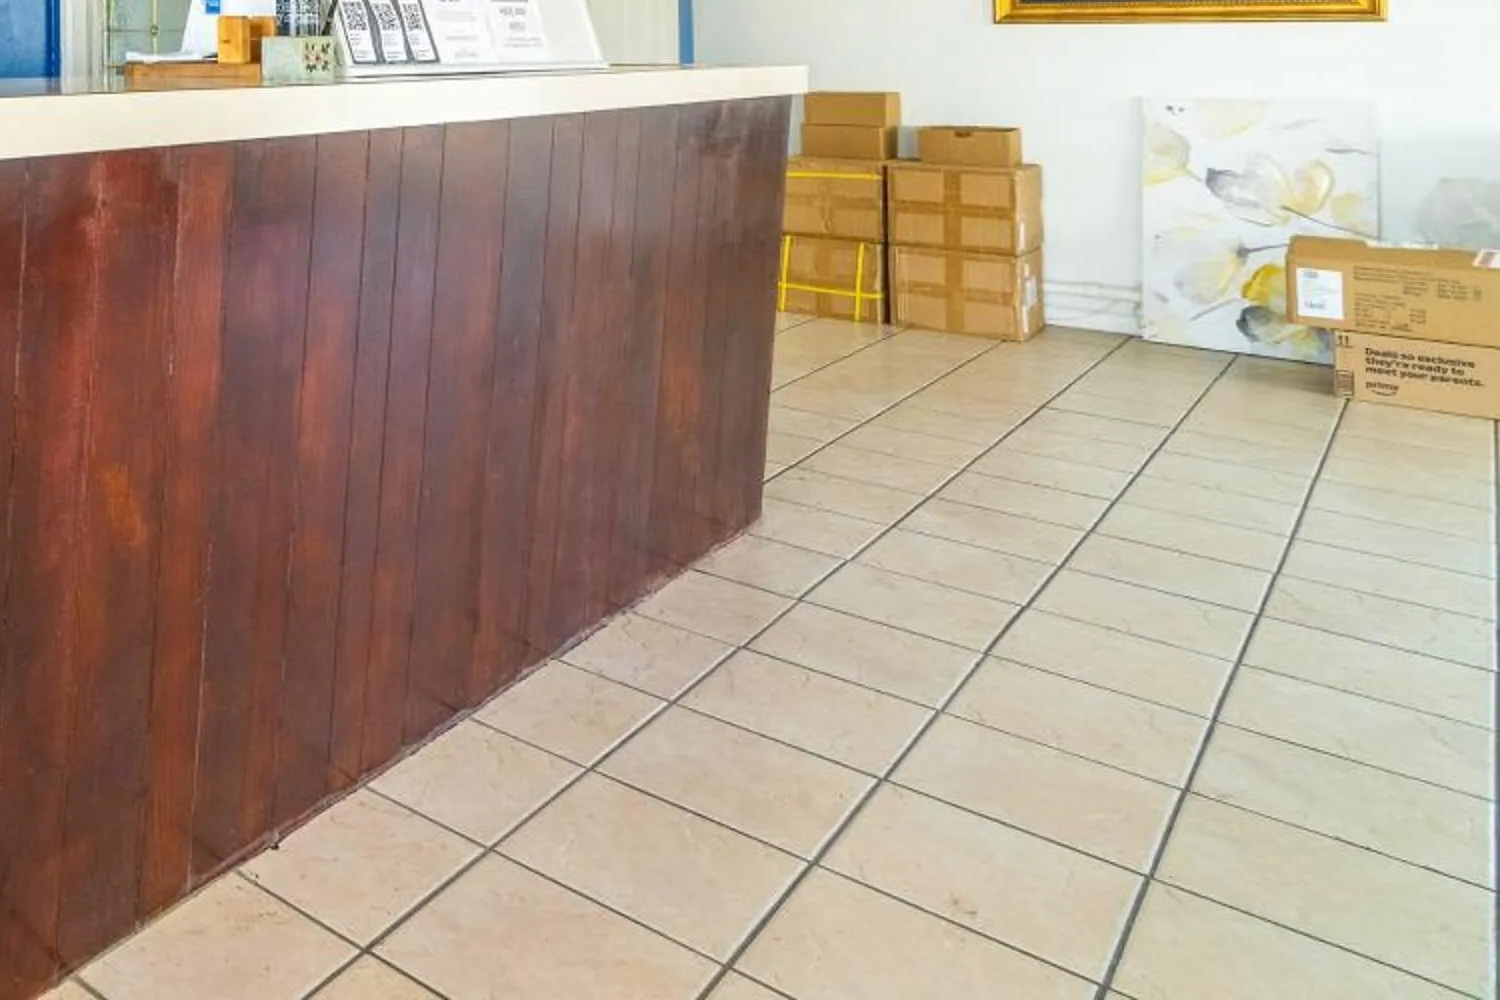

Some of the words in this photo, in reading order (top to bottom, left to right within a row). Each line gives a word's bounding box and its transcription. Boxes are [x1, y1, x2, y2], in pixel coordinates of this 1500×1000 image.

[1364, 347, 1398, 358] Deals
[1400, 352, 1415, 361] so
[1417, 354, 1476, 368] exclusive
[1364, 356, 1409, 370] they're
[1411, 362, 1449, 375] ready
[1450, 367, 1465, 376] to
[1364, 365, 1398, 377] meet
[1399, 371, 1429, 380] your
[1365, 380, 1399, 391] prime
